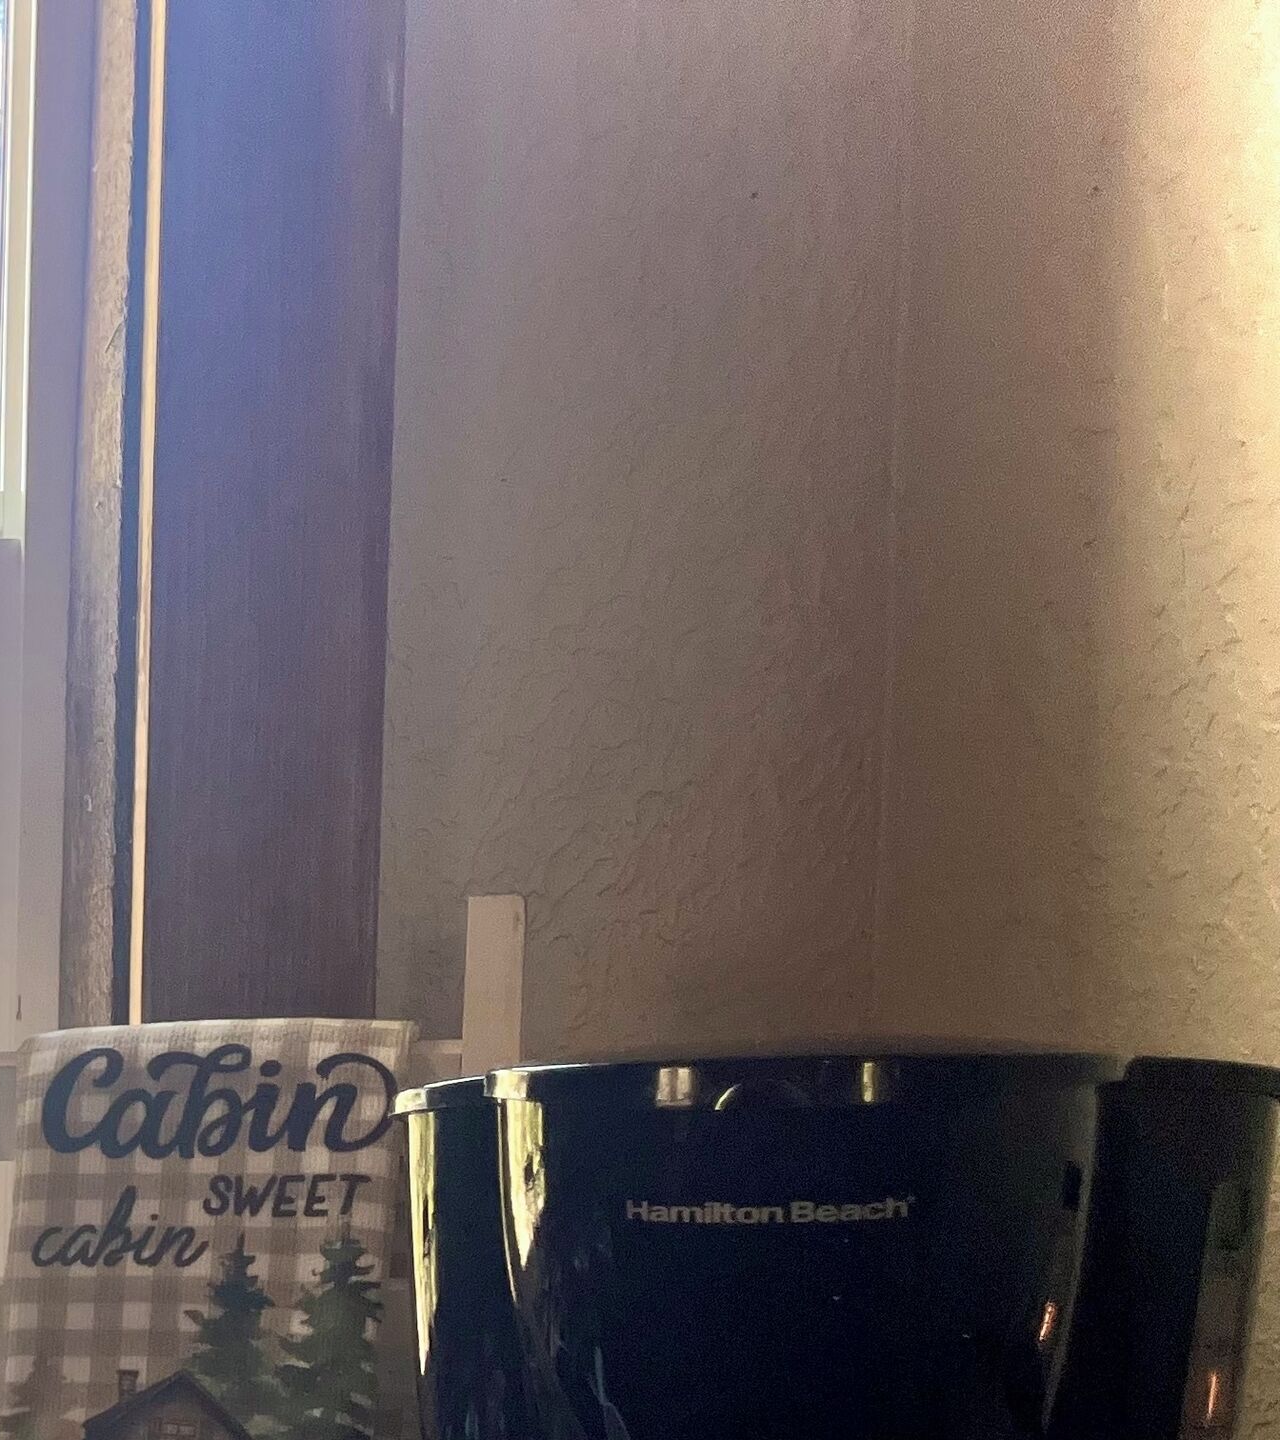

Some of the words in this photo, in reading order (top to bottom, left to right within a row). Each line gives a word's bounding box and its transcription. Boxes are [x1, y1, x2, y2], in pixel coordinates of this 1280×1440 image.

[41, 1042, 398, 1160] Cabin
[31, 1184, 210, 1268] cabin
[202, 1172, 371, 1219] SWEET
[626, 1199, 785, 1224] Hamilton
[791, 1198, 910, 1223] Beach
